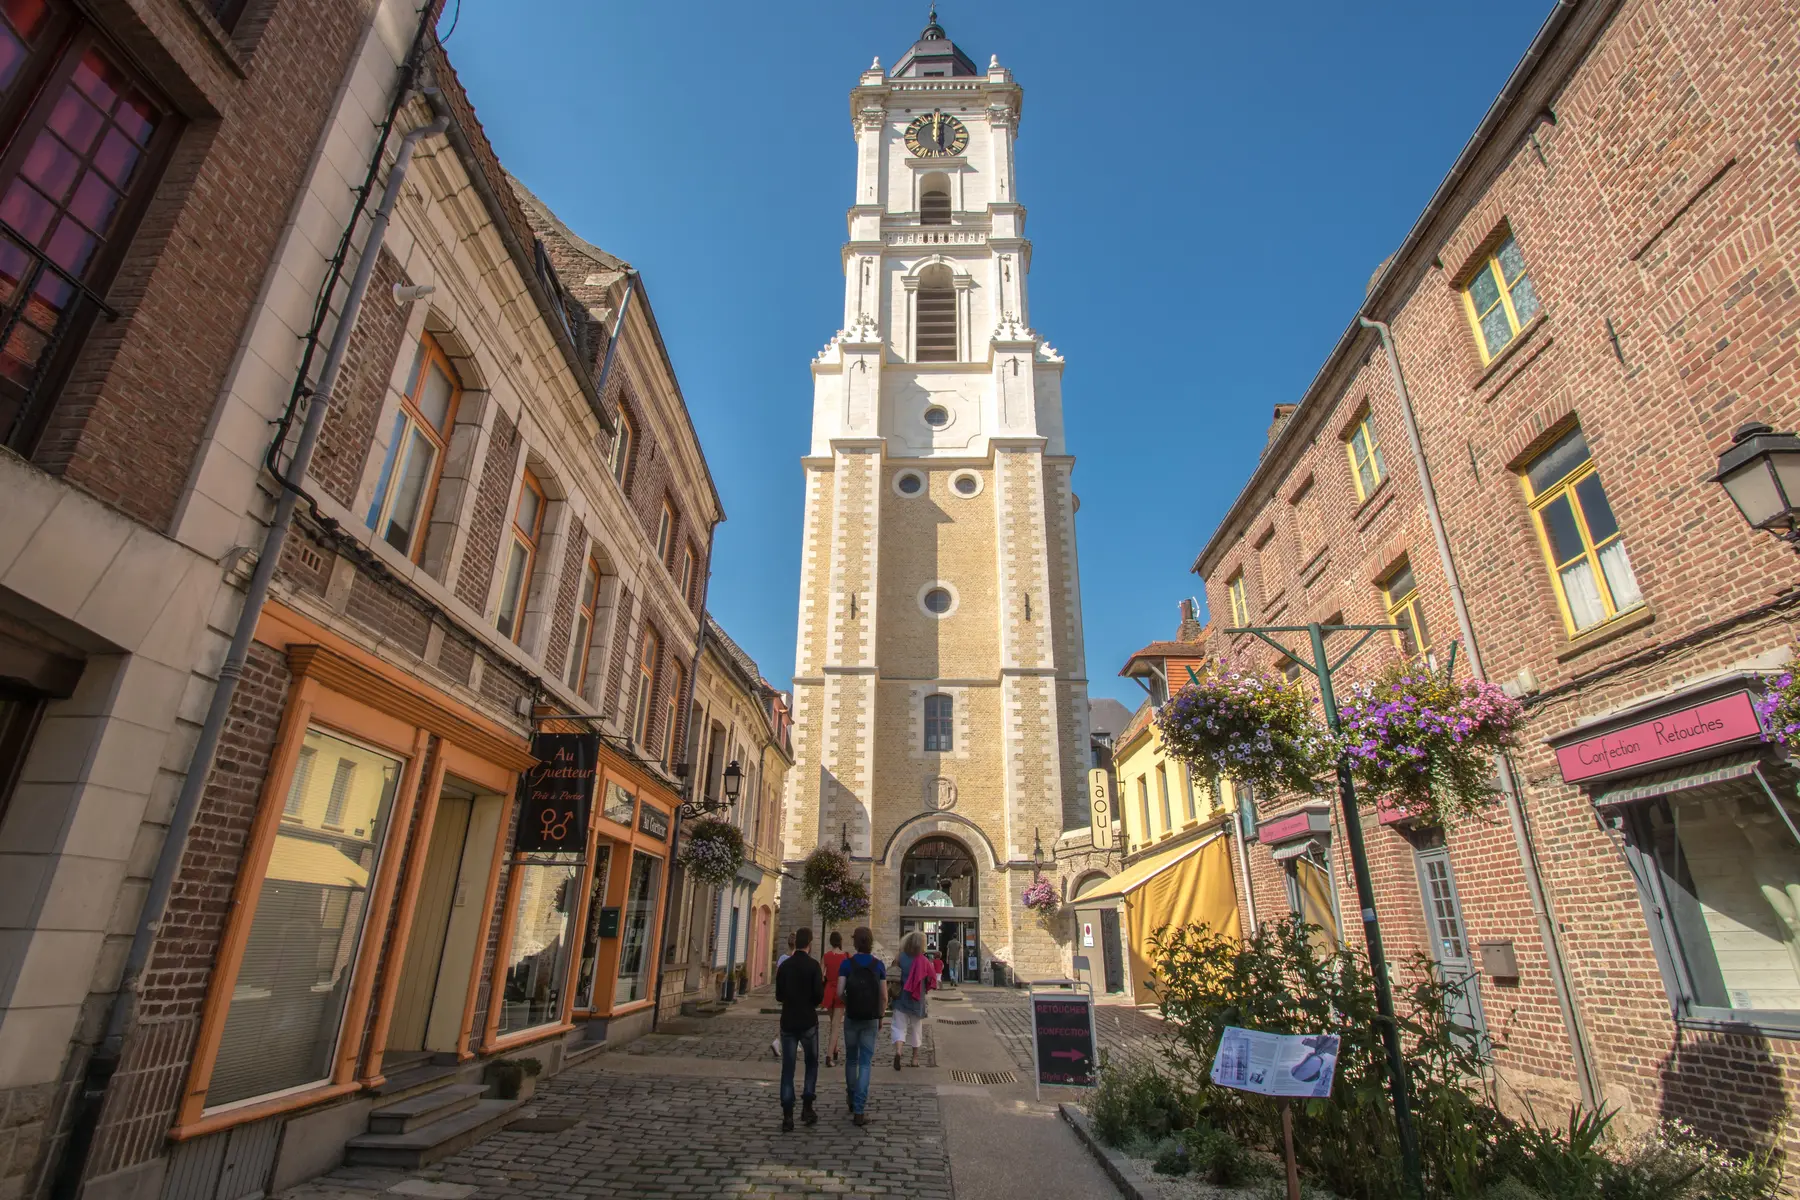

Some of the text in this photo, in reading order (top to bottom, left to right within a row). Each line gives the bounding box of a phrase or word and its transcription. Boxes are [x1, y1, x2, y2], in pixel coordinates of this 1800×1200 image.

[1577, 710, 1725, 768] Confection Retouches
[554, 747, 574, 761] Au
[528, 760, 594, 787] Guetteur
[1093, 771, 1107, 847] raoul
[1037, 1004, 1087, 1014] RETOUCHES
[1037, 1026, 1090, 1037] CONFECTION
